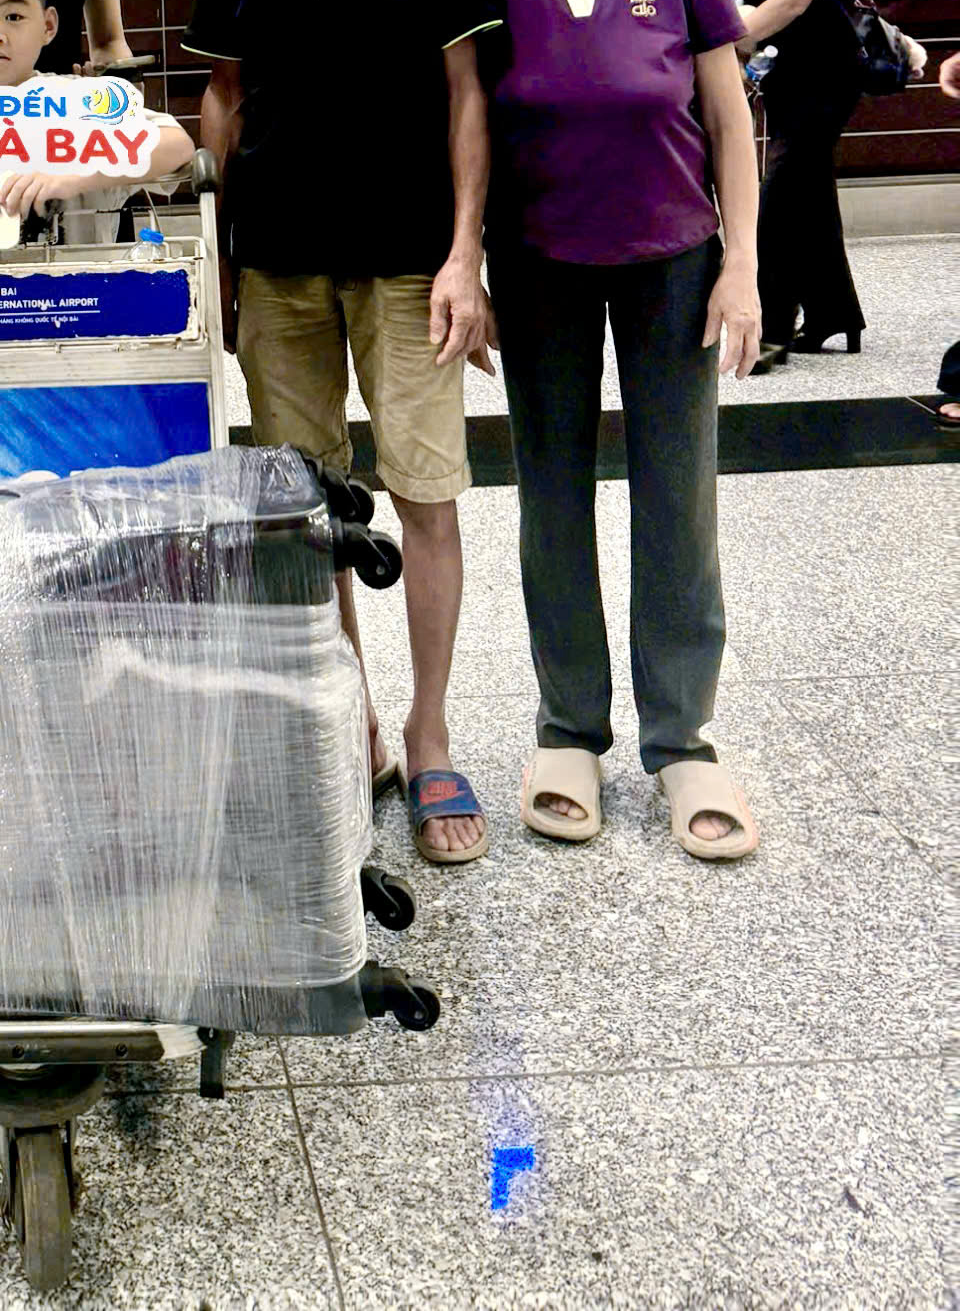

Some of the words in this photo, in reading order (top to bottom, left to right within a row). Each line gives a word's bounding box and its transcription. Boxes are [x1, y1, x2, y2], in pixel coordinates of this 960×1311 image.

[46, 128, 149, 166] BAY
[0, 287, 17, 297] BAI
[58, 297, 99, 308] AIRPORT
